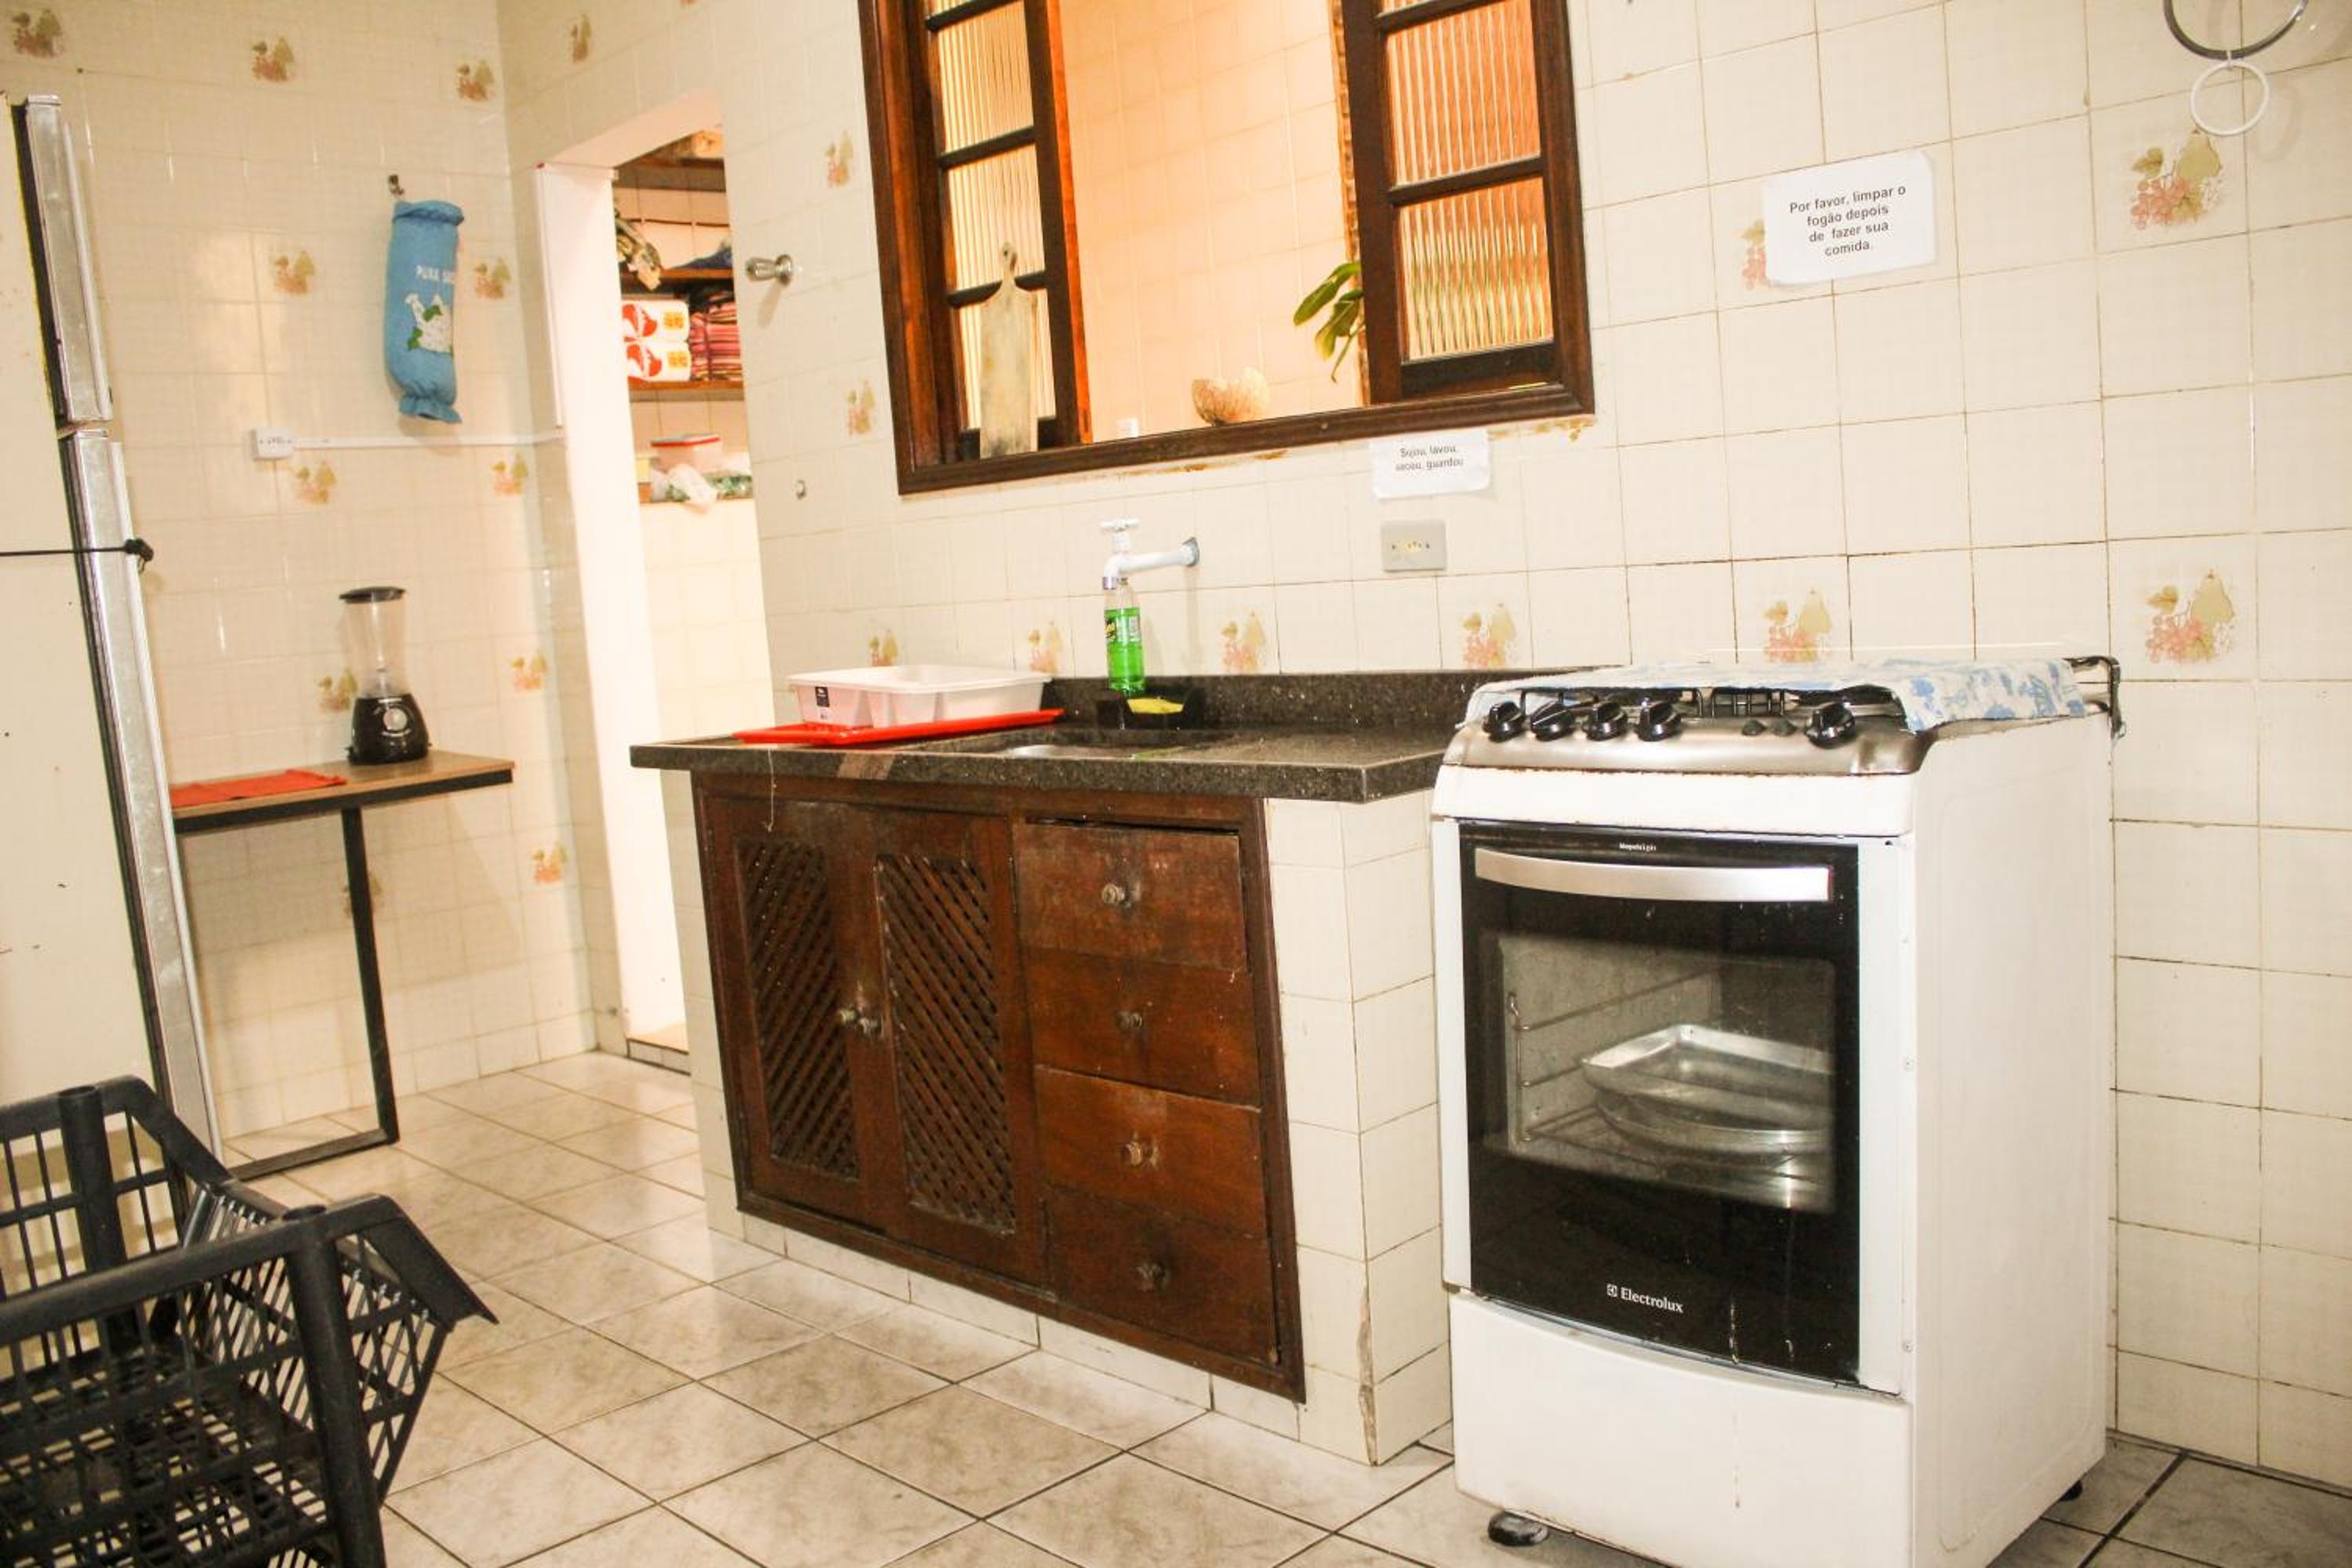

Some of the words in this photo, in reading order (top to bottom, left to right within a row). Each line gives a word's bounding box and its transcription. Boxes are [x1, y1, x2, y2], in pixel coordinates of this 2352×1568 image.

[1790, 201, 1809, 213] Por
[1815, 196, 1849, 210] favor,
[1853, 187, 1893, 203] limpar
[1898, 186, 1906, 195] o
[1807, 213, 1842, 228] fogão
[1846, 205, 1889, 220] depois
[1809, 231, 1824, 242] de
[1832, 225, 1861, 238] fazer
[1866, 222, 1889, 233] sua
[1621, 1287, 1683, 1313] Electrolux
